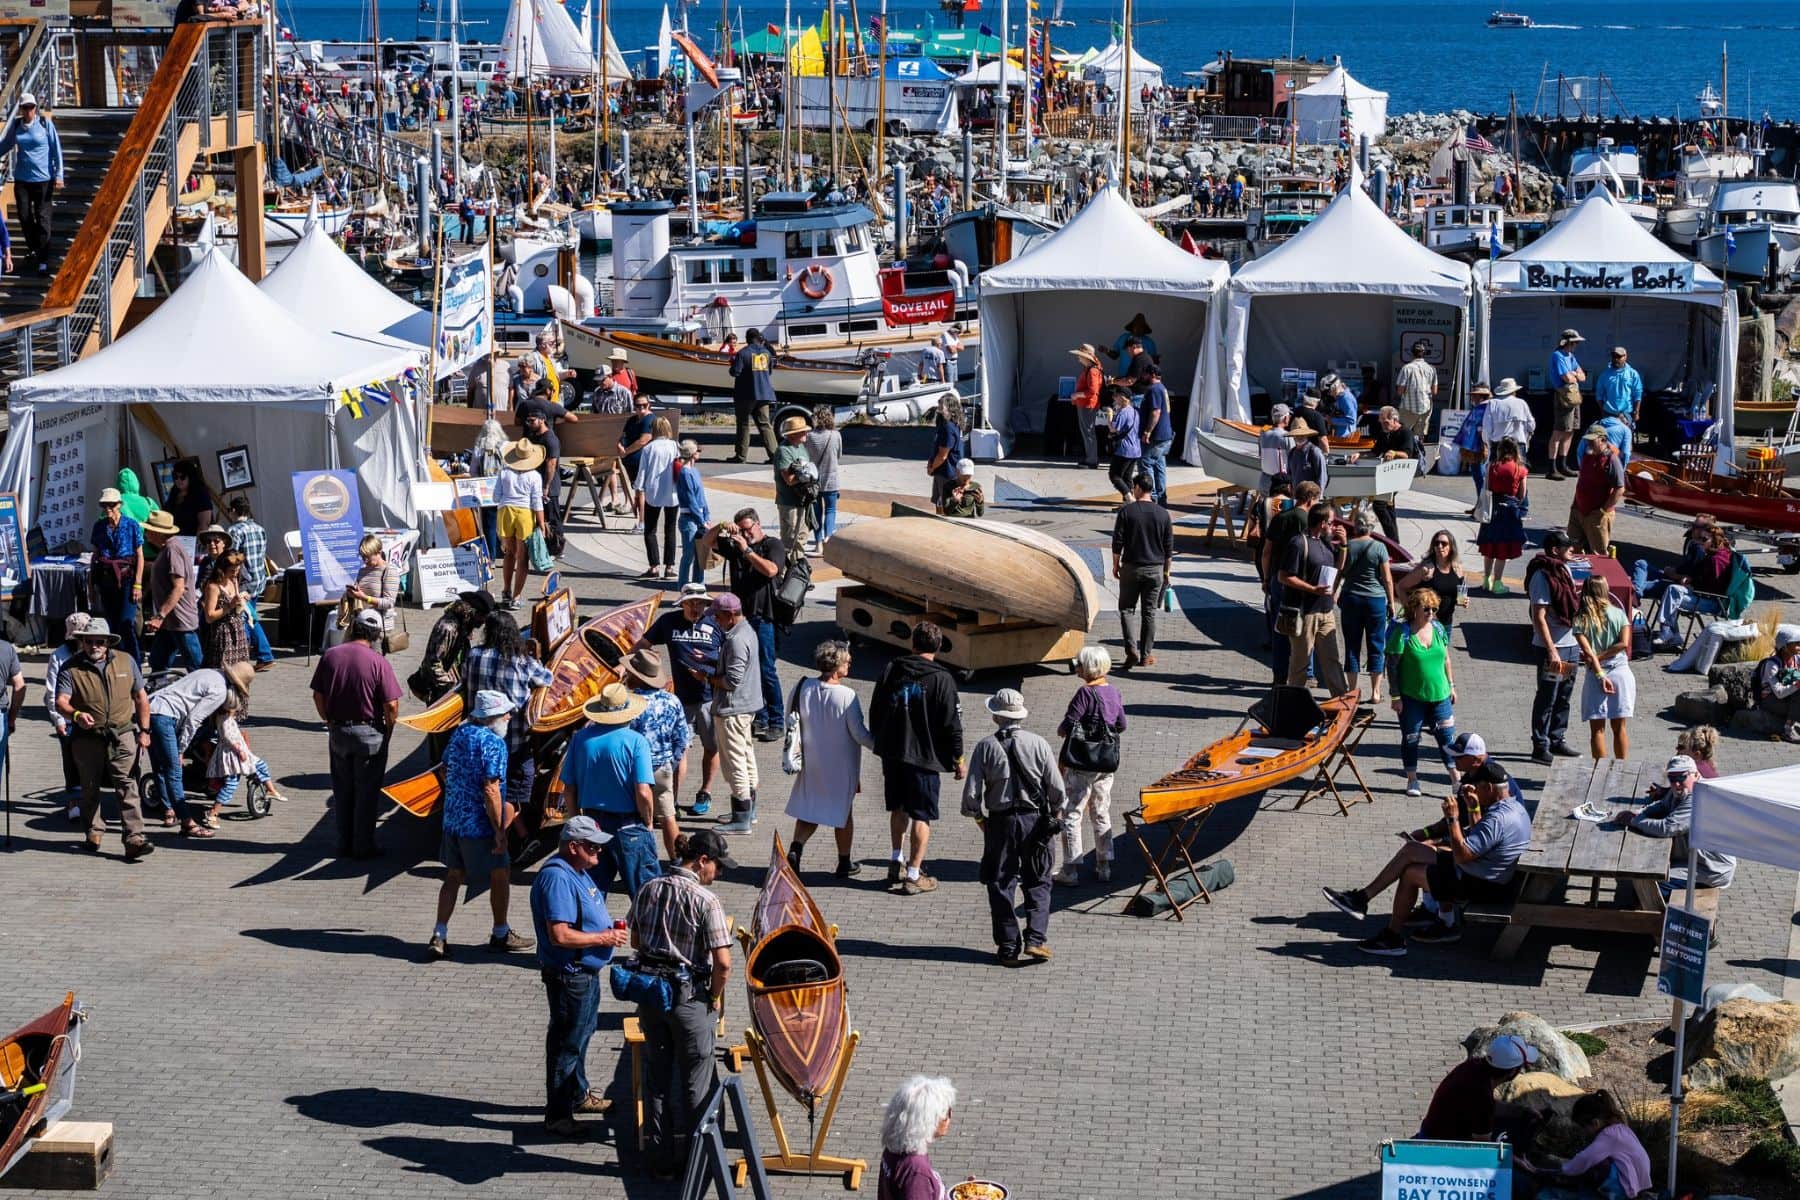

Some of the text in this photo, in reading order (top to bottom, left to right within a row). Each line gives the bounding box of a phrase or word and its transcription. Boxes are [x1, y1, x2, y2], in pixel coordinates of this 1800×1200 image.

[1527, 264, 1685, 289] Bartender Boats
[891, 299, 948, 313] DOVETAIL
[35, 404, 103, 432] HARBOR HISTORY MUSEUM
[439, 561, 476, 569] COMMUNITY
[434, 569, 464, 577] BOATYARD
[1669, 922, 1703, 940] MEET HERE
[1666, 946, 1702, 965] BAY TOURS
[1398, 1175, 1496, 1188] PORT TOWNSEND
[1398, 1188, 1496, 1200] BAY TOURS
